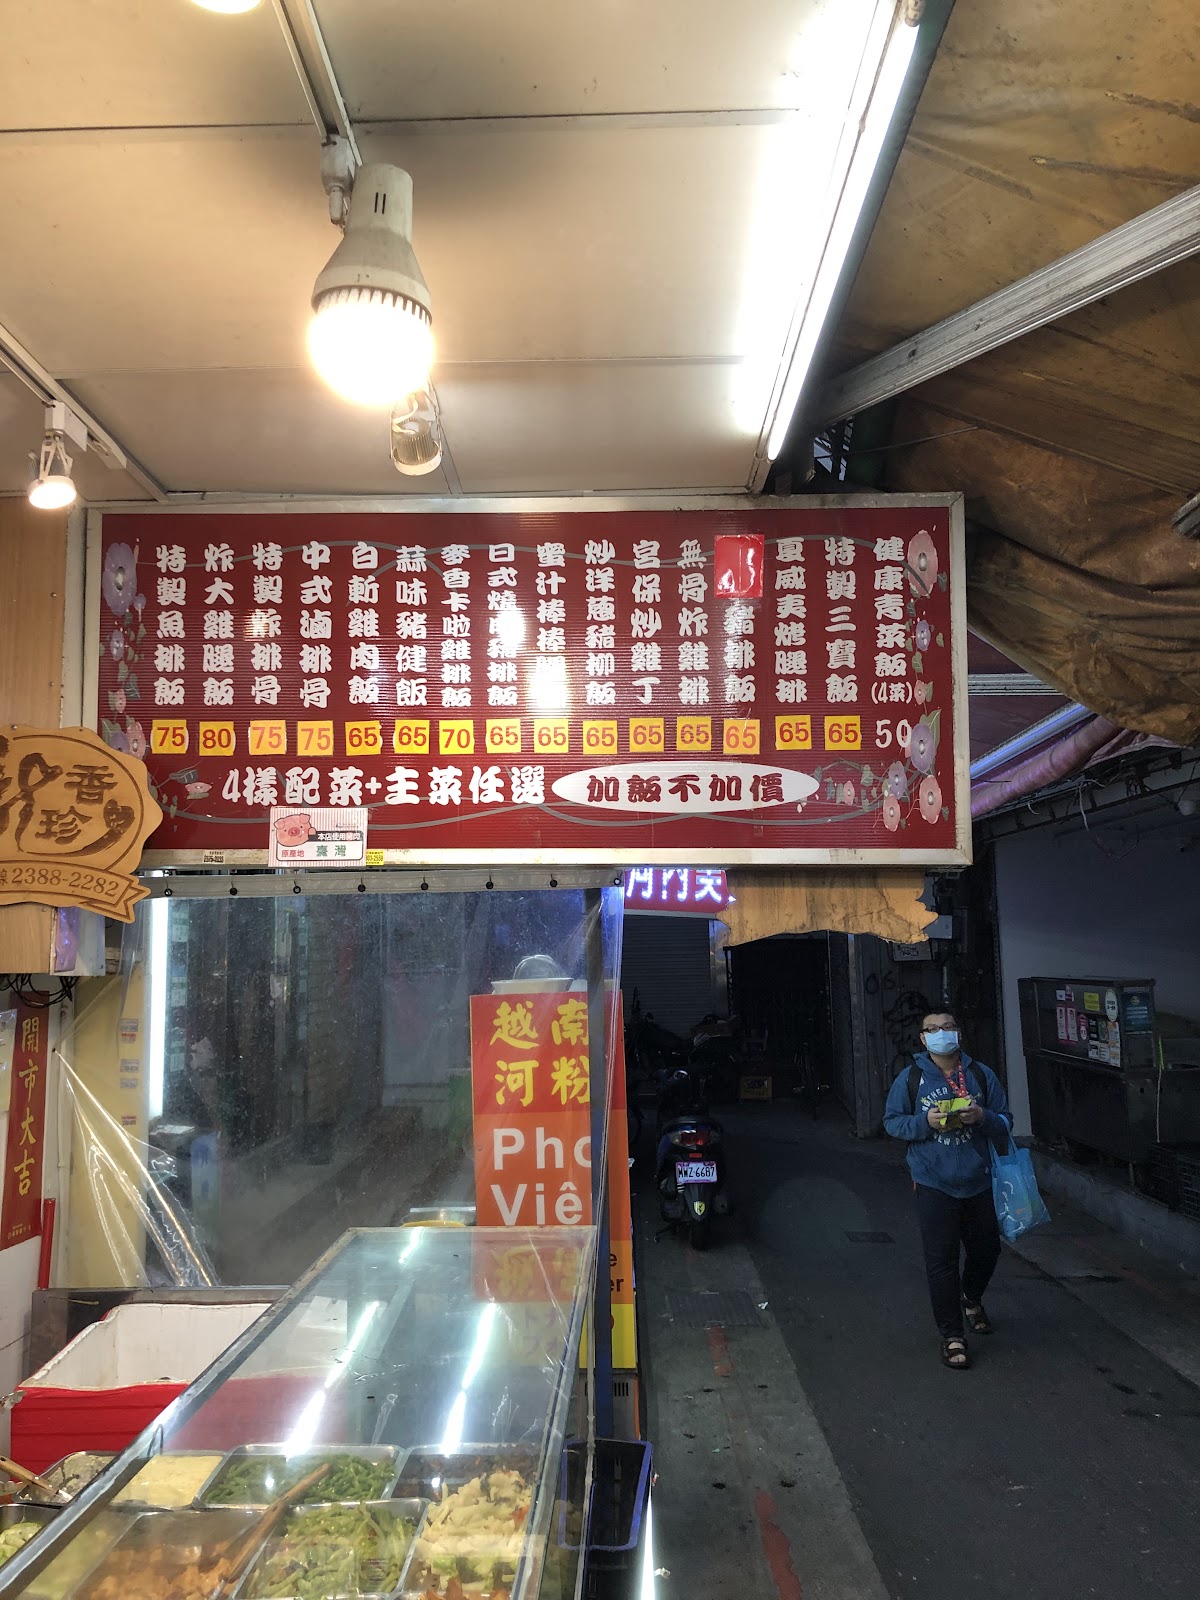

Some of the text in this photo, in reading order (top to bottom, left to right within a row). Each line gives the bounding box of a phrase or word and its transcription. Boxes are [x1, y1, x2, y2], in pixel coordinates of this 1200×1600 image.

[873, 537, 907, 677] 健康青菜飯
[153, 543, 187, 706] 特製魚排飯
[203, 543, 235, 706] 炸大雞腿飯
[251, 542, 283, 705] 特製炸排骨
[299, 540, 333, 708] 中式滷排骨
[348, 541, 380, 704] 白斬雞肉飯
[441, 544, 471, 708] 麥香卡啦雞排飯
[630, 539, 662, 705] 宮保炒雞丁
[677, 539, 710, 705] 無骨炸雞排
[774, 537, 807, 704] 夏威夷烤腿排
[824, 537, 858, 704] 特製三寶飯
[156, 725, 186, 749] 75
[202, 728, 233, 750] 80
[252, 725, 283, 749] 75
[300, 727, 332, 751] 75
[348, 726, 379, 748] 65
[397, 725, 428, 747] 65
[442, 728, 471, 750] 70
[489, 724, 519, 747] 65
[537, 726, 567, 747] 65
[586, 726, 616, 748] 65
[633, 724, 663, 746] 65
[680, 723, 710, 745] 65
[725, 725, 757, 749] 65
[779, 721, 810, 744] 65
[828, 722, 859, 744] 65
[875, 718, 912, 748] 50
[586, 773, 785, 804] 加飯不加價
[281, 849, 305, 858] 原產地
[14, 1017, 40, 1196] 開市大吉
[490, 1181, 593, 1226] Viê
